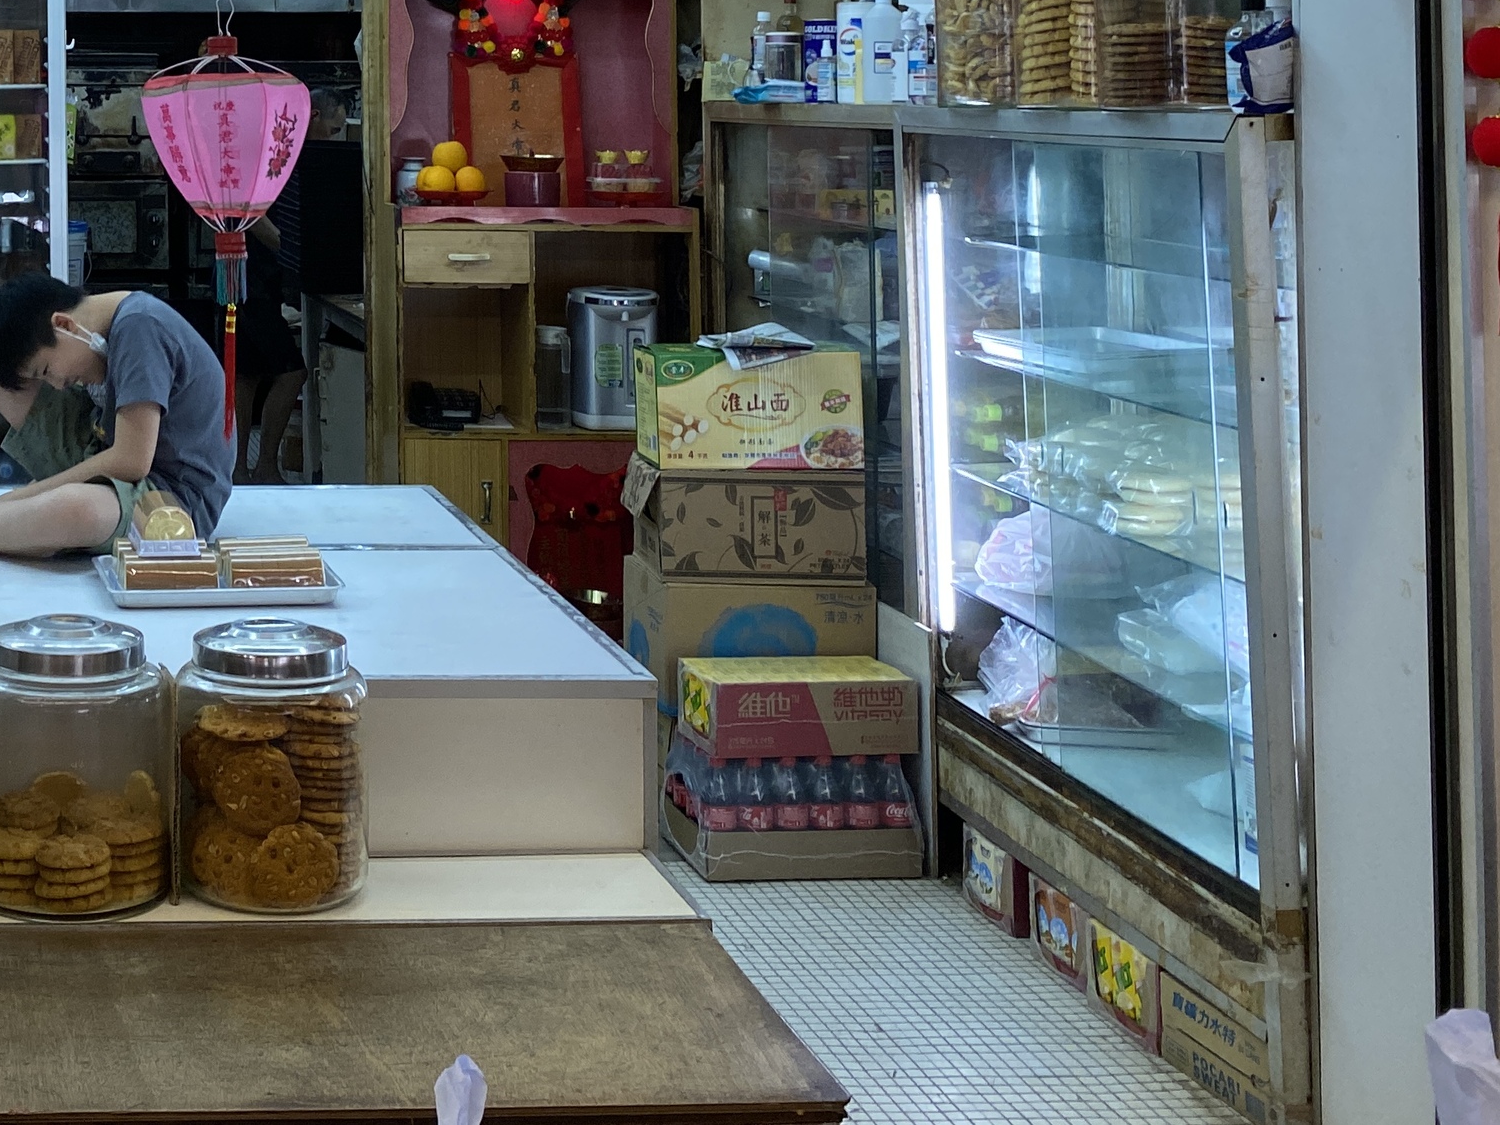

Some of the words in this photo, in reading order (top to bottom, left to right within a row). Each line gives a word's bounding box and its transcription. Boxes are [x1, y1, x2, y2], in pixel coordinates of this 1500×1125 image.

[721, 392, 790, 413] 淮山面
[738, 692, 791, 719] 維他
[1192, 1051, 1241, 1095] POCARI
[1192, 1066, 1237, 1106] SWEAT
